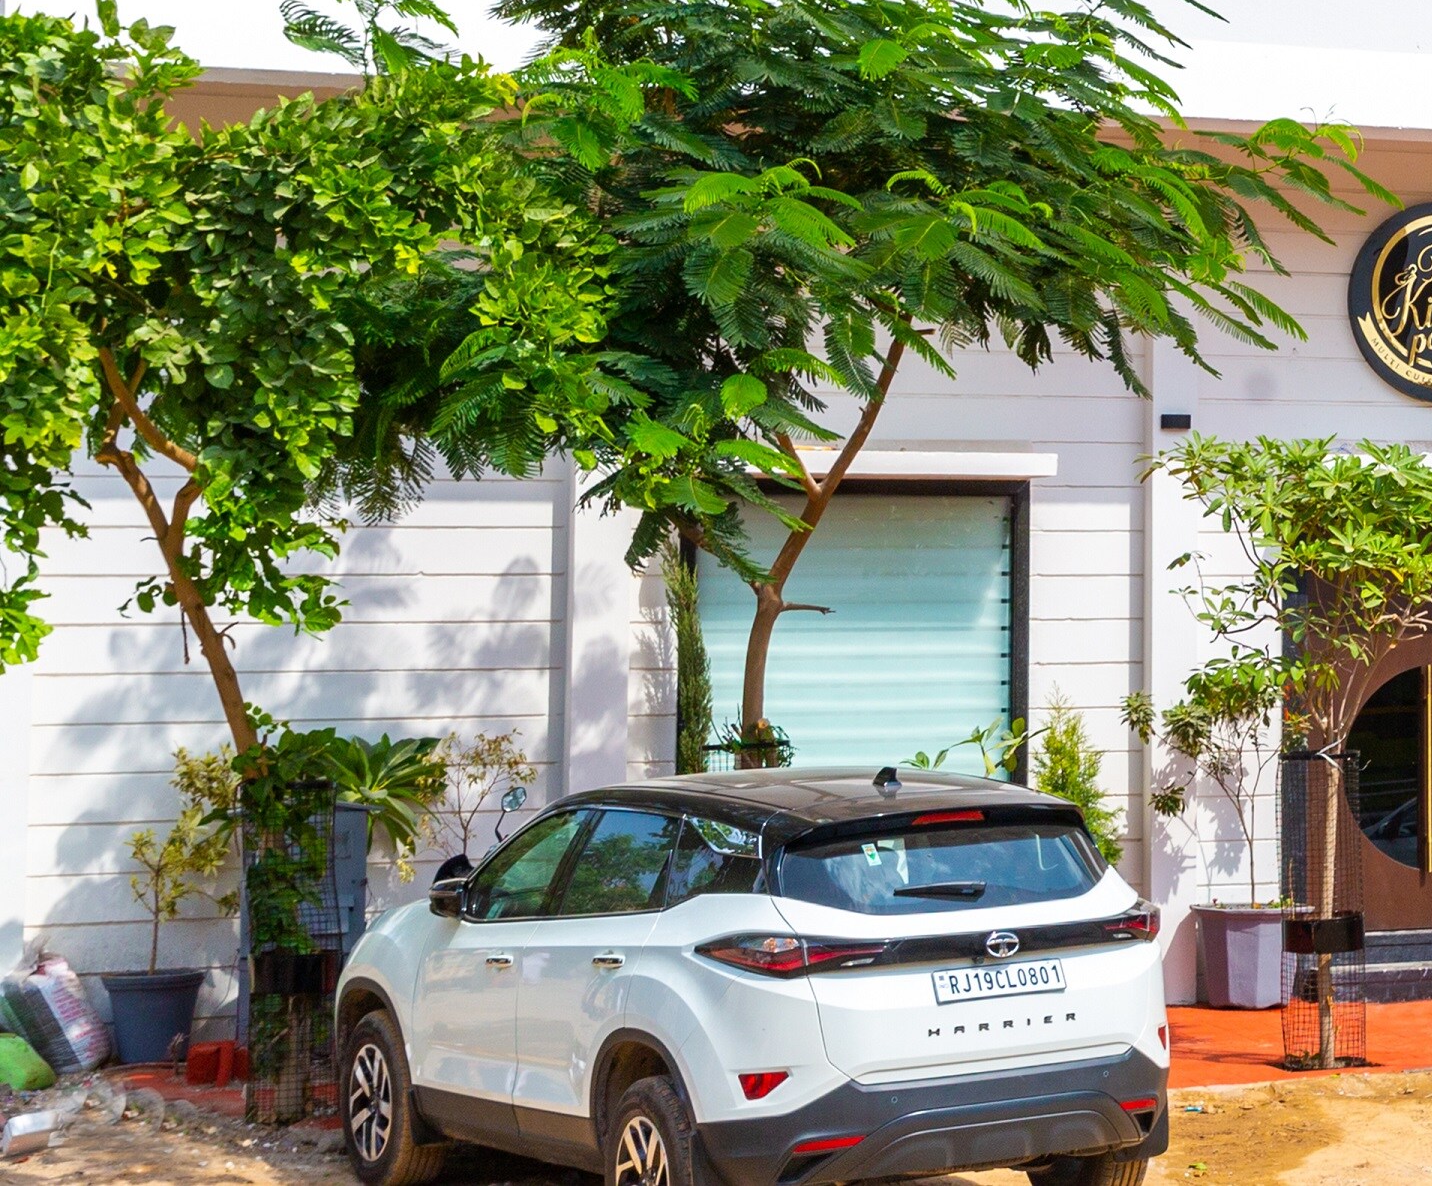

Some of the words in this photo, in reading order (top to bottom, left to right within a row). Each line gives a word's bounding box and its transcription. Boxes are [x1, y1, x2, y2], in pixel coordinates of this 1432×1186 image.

[1371, 338, 1399, 369] MULTI
[949, 965, 1061, 994] RJ19CL0801
[928, 1013, 1076, 1037] HARRIER
